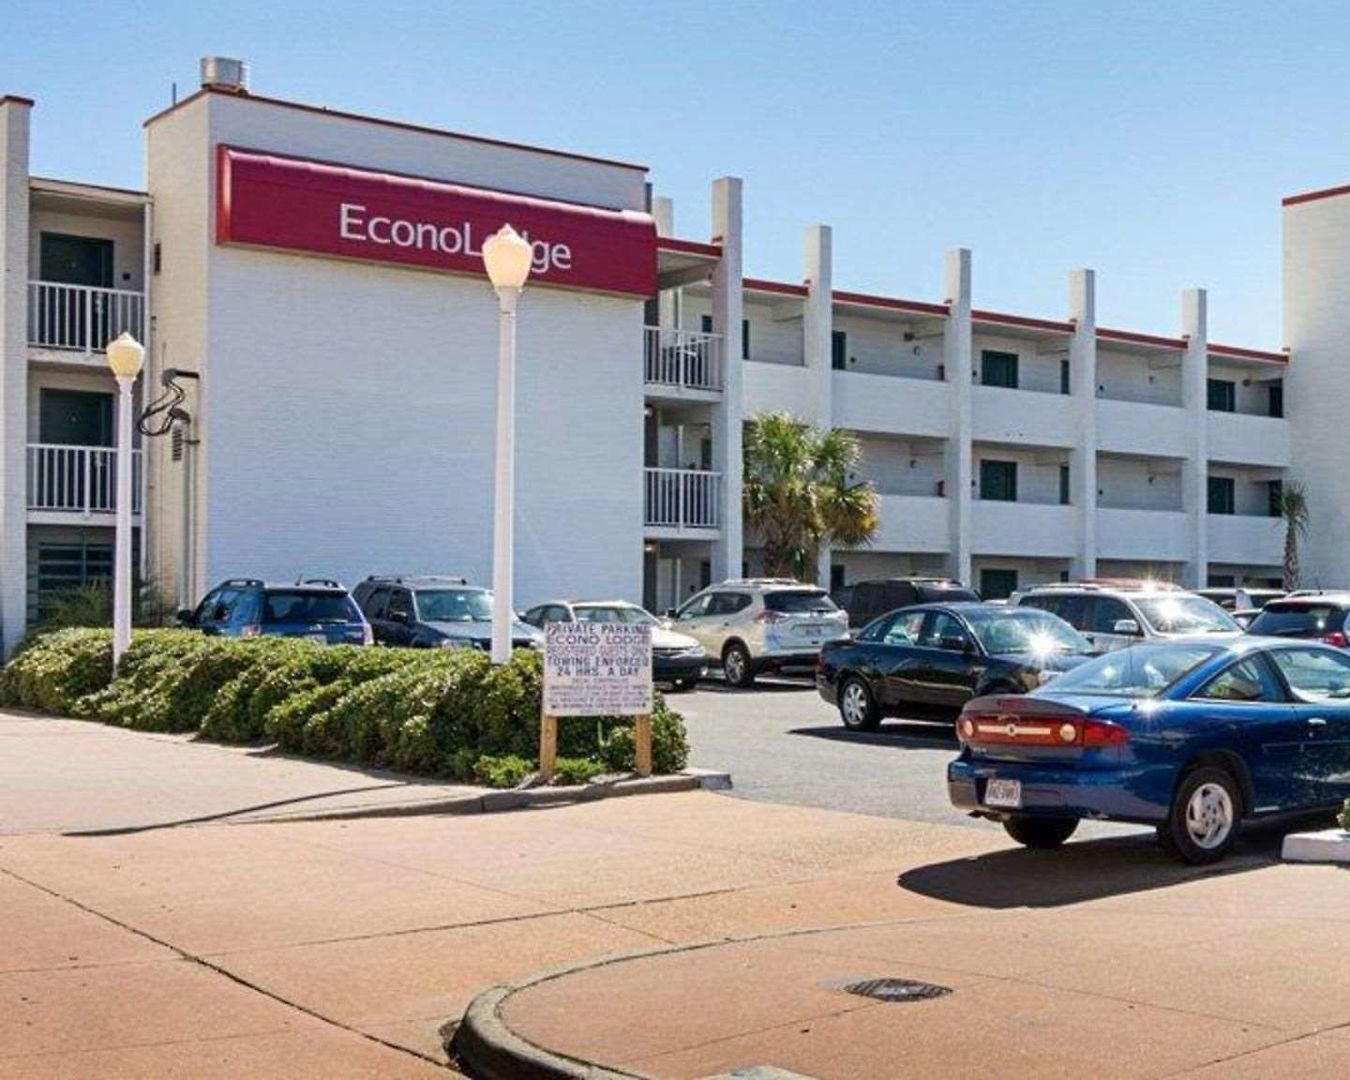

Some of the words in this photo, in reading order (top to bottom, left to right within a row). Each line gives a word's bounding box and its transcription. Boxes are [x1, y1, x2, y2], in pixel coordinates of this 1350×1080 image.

[341, 203, 572, 274] EconoLge
[547, 634, 600, 644] ECONO
[606, 634, 648, 645] LODGE
[547, 656, 591, 666] TOWING
[595, 656, 649, 667] ENFORCED
[557, 667, 571, 676] 24
[607, 667, 615, 676] A
[619, 667, 639, 676] DAY
